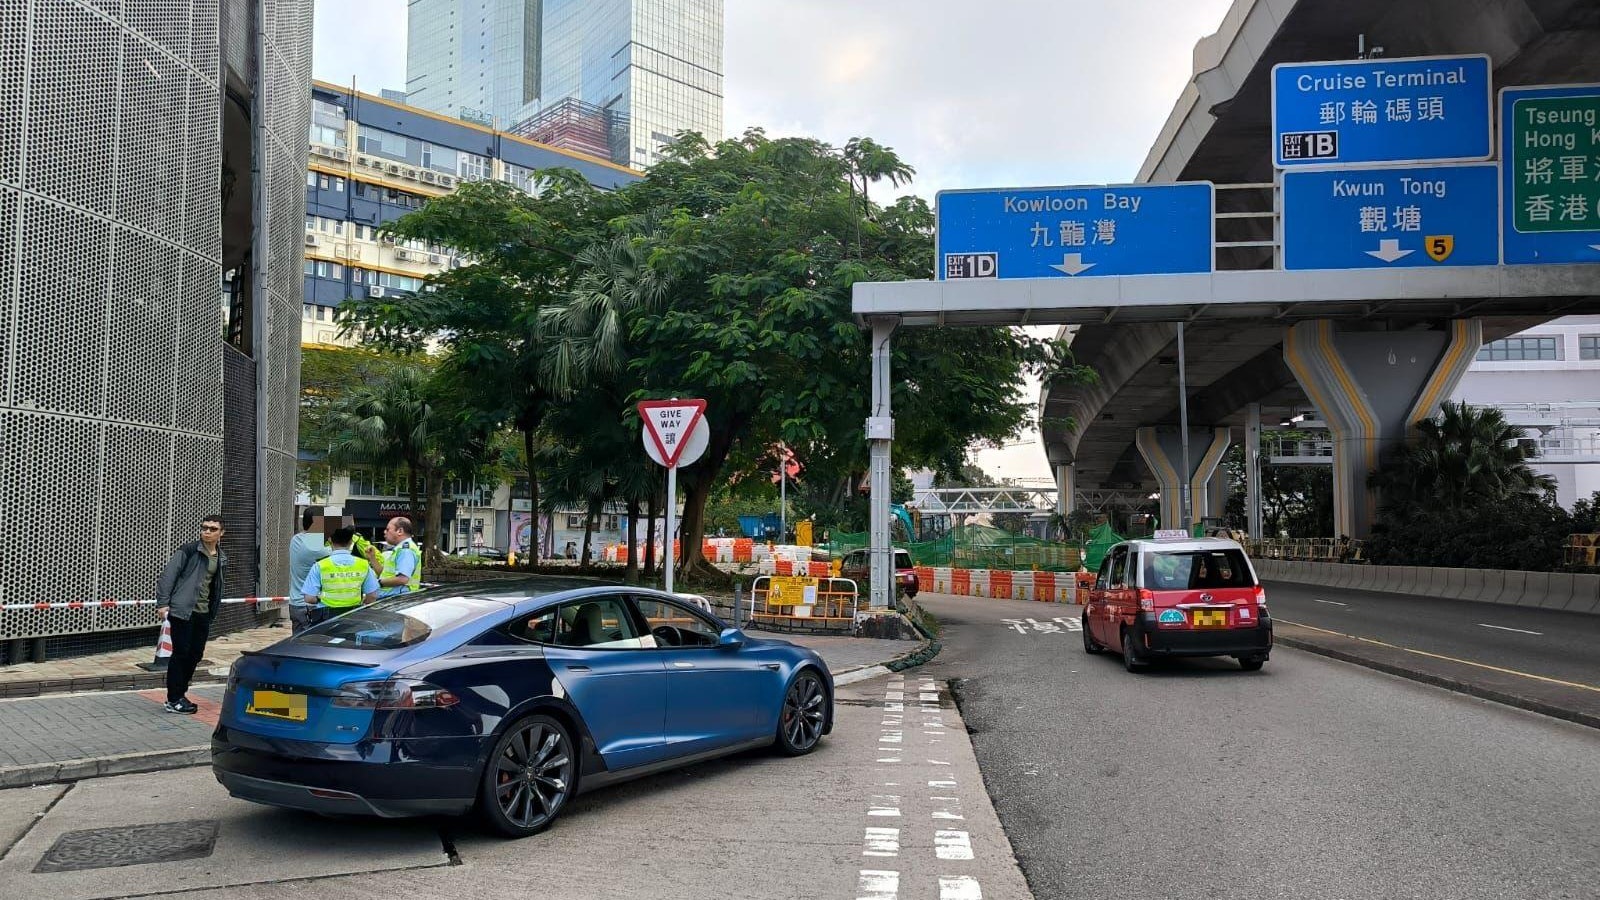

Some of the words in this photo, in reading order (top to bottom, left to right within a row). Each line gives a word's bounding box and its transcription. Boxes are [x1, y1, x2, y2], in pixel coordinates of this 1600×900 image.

[1297, 73, 1366, 92] Cruise
[1372, 67, 1467, 88] Terminal
[1319, 96, 1445, 125] 郵輪碼頭
[1525, 107, 1596, 127] Tseung
[1284, 135, 1302, 145] EXIT
[1305, 134, 1334, 157] 1B
[1525, 130, 1576, 150] Hong
[1284, 145, 1301, 157] 出
[1524, 155, 1600, 185] 將軍
[1333, 180, 1385, 197] Kwun
[1400, 178, 1446, 198] Tong
[1004, 196, 1088, 213] Kowloon
[1103, 193, 1142, 213] Bay
[1359, 205, 1422, 232] 觀塘
[1030, 218, 1116, 248] 九龍灣
[1433, 239, 1446, 256] 5
[948, 256, 964, 265] EXIT
[967, 255, 995, 277] 1D
[948, 265, 963, 277] 出
[660, 409, 682, 418] GIVE
[660, 420, 681, 428] WAY
